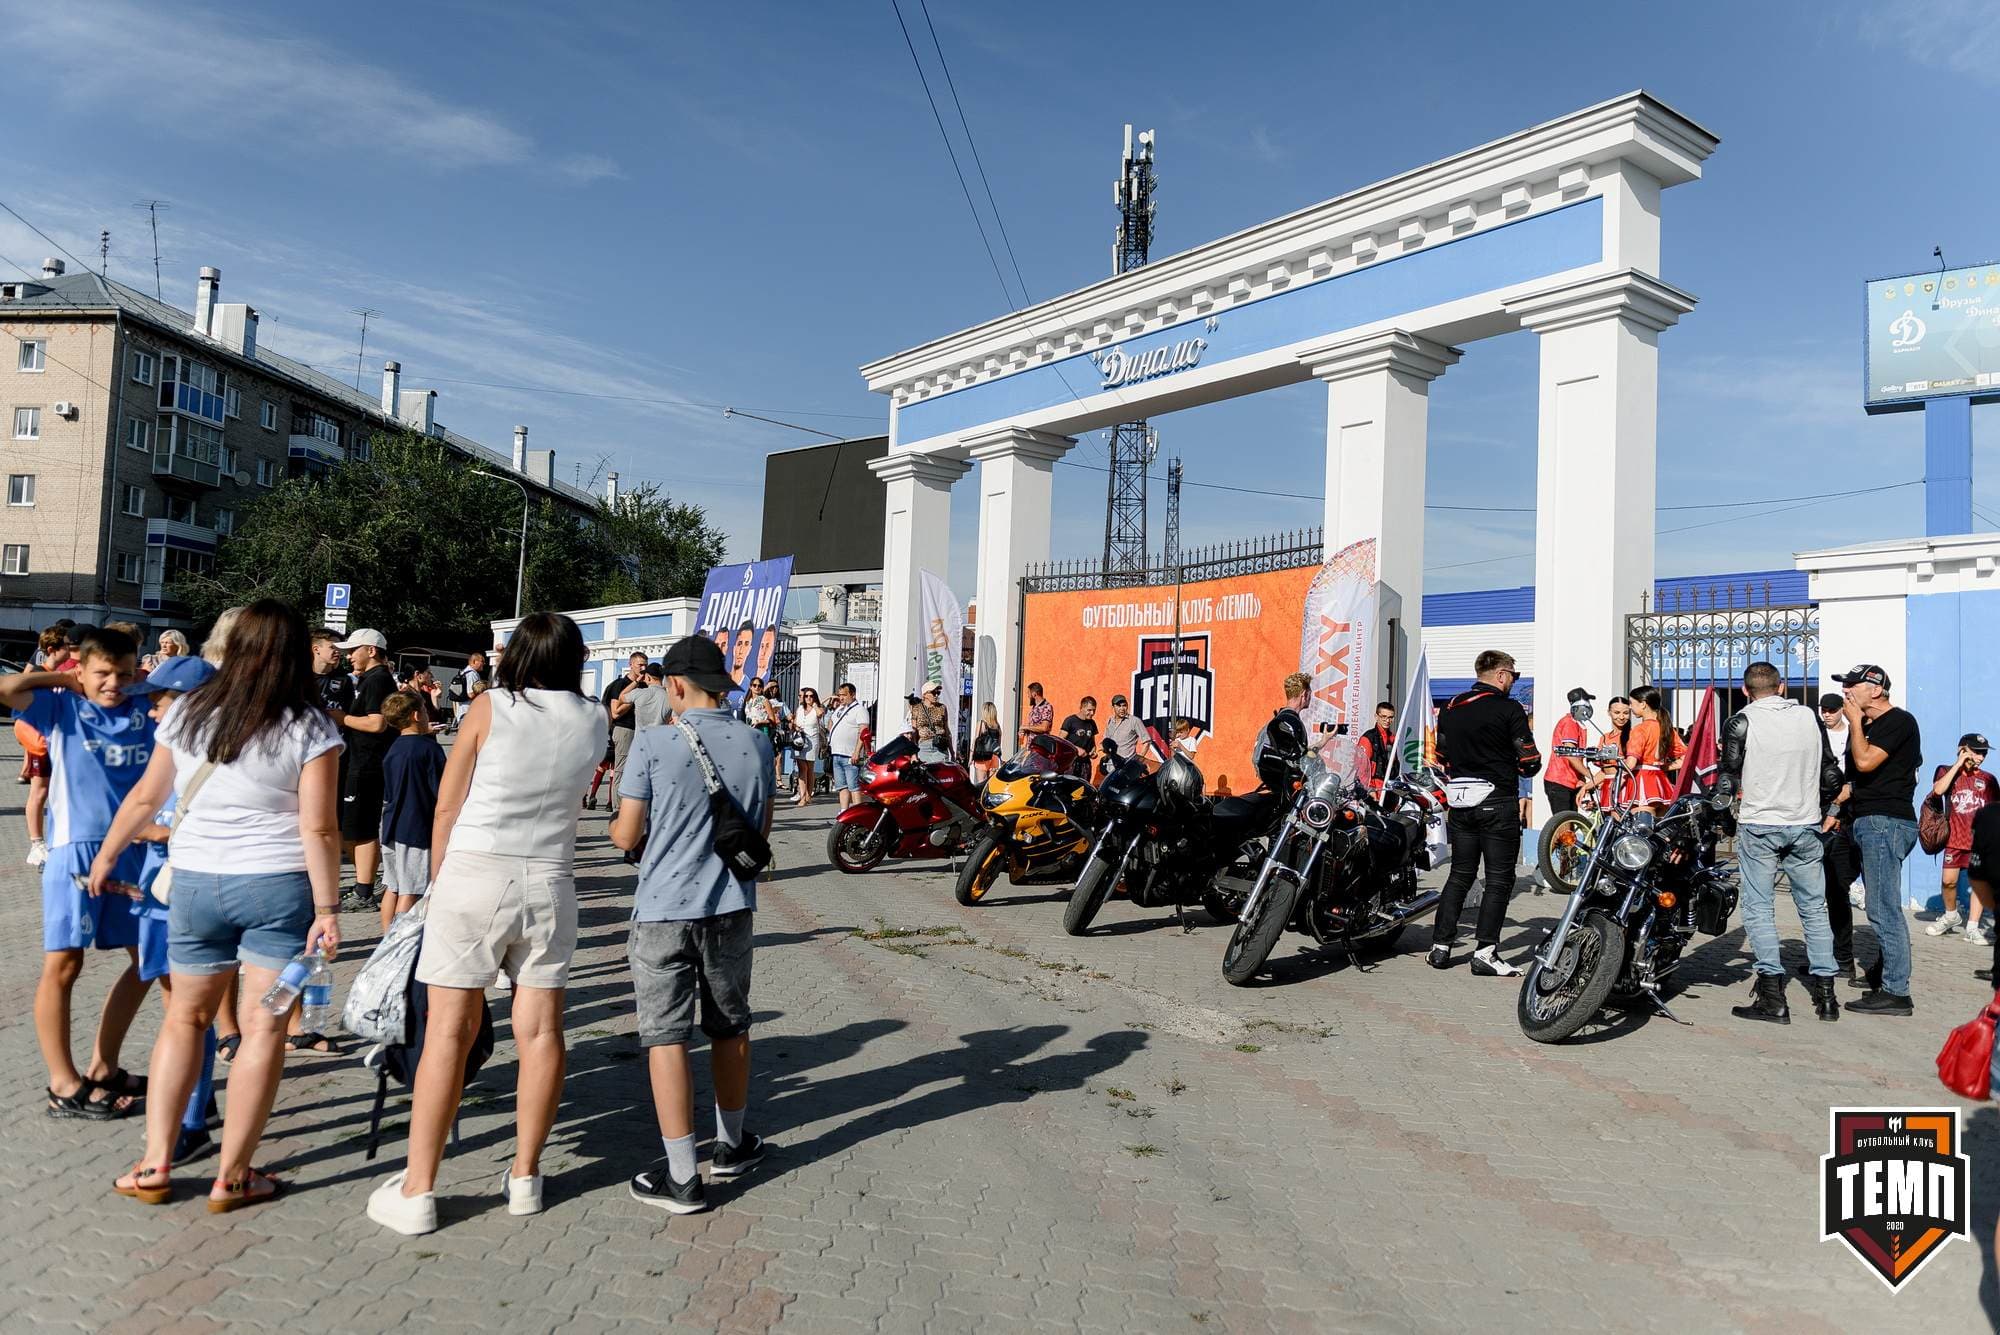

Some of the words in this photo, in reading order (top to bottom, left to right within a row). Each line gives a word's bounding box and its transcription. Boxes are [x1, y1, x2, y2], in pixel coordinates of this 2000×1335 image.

[701, 585, 782, 636] ДИНАМО
[1083, 596, 1175, 628] ФУТБОЛЬНЫЙ
[1182, 598, 1212, 625] КЛУБ
[1216, 593, 1262, 622] «ТЕМП»
[1355, 621, 1363, 653] ЦЕНТР
[1140, 673, 1207, 723] ТЕМП
[1351, 655, 1361, 744] ЗВЛЕКАТЕЛЬНЫЙ
[105, 743, 149, 766] ВТБ
